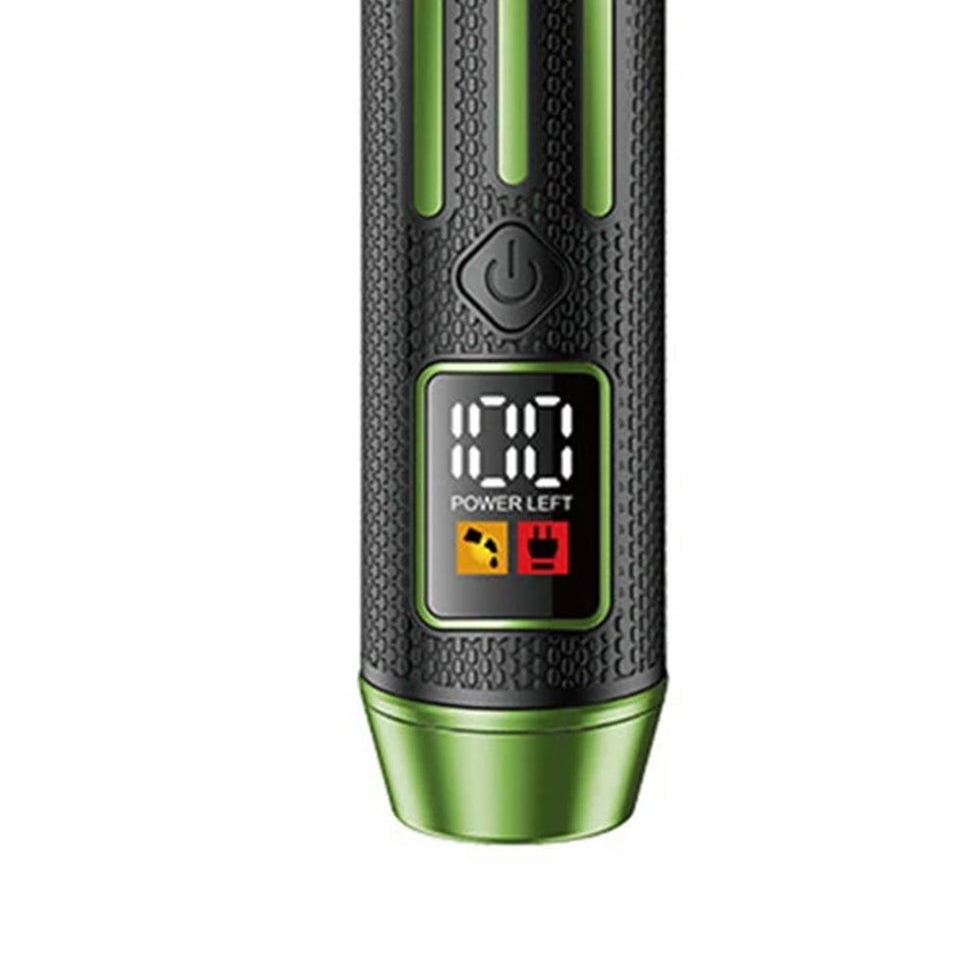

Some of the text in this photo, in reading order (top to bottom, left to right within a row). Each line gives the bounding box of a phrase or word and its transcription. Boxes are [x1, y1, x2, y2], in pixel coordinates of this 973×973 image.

[451, 395, 573, 489] 100
[451, 494, 573, 512] POWER LEFT
